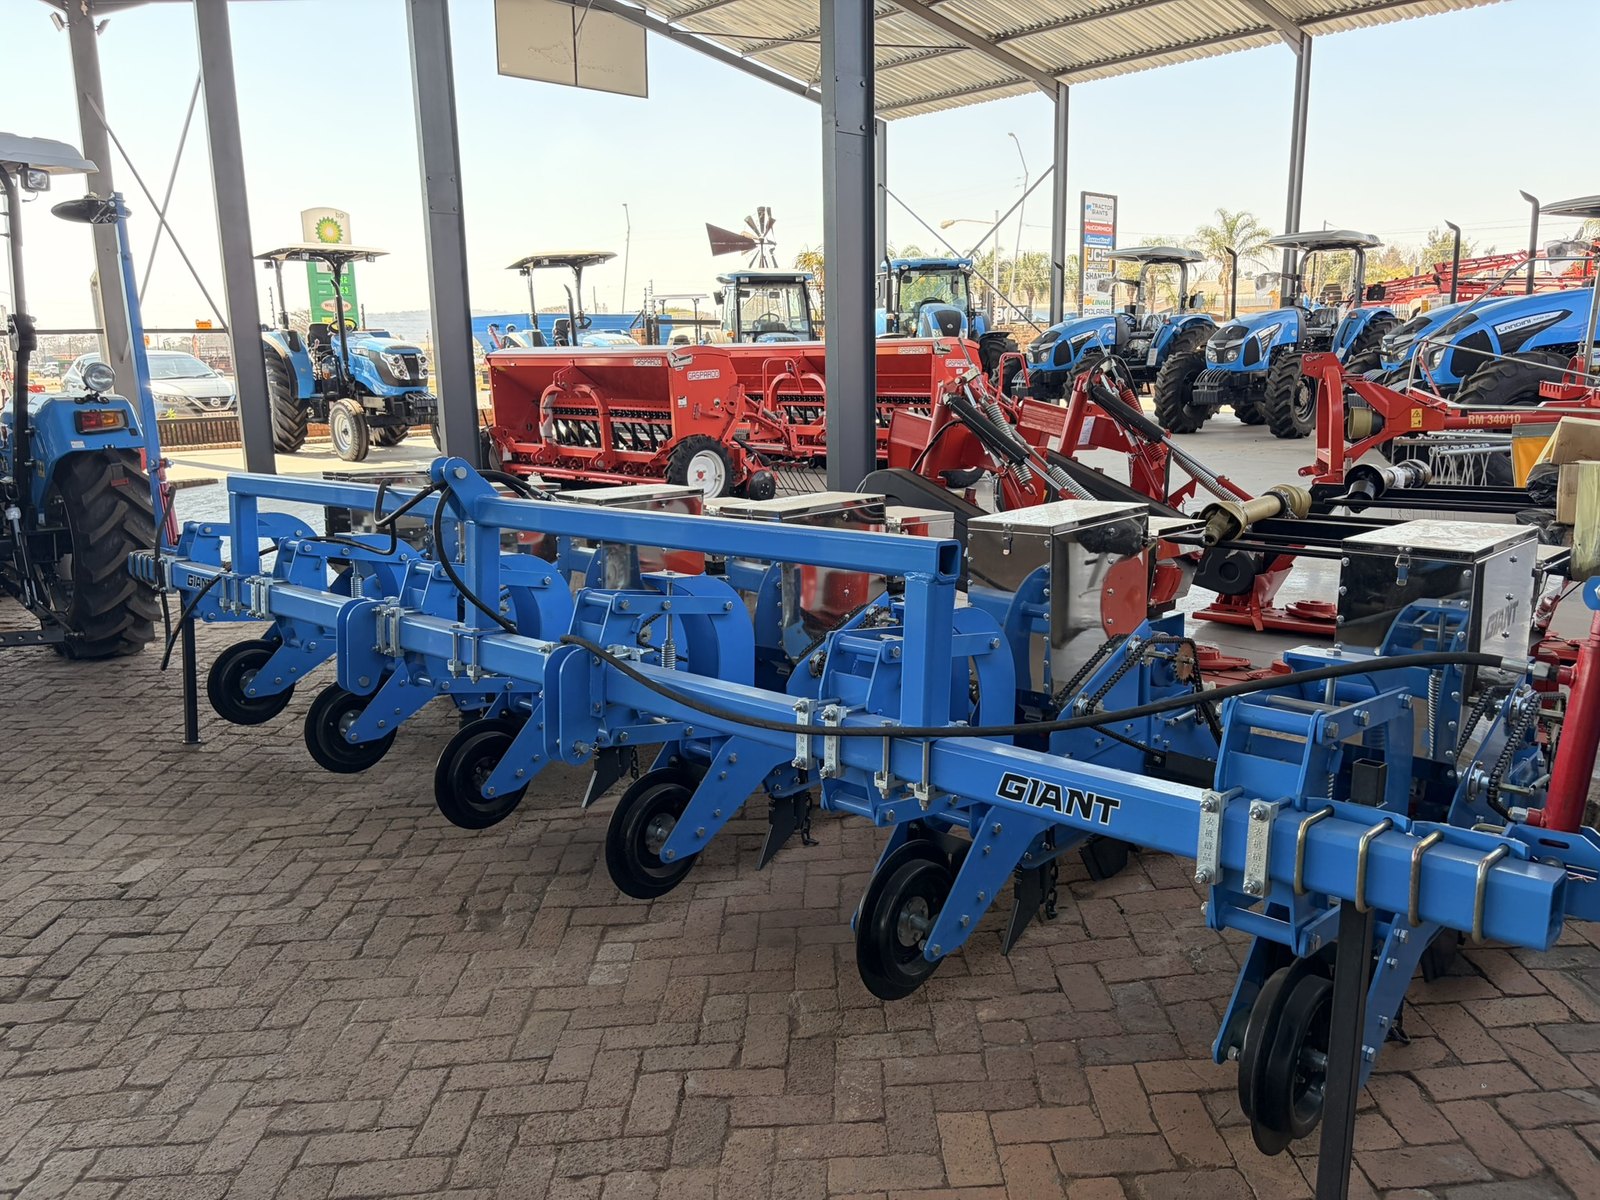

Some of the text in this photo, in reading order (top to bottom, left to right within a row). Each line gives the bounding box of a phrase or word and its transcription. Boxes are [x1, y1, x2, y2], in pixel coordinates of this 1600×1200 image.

[1092, 203, 1113, 211] TRACTOR
[1091, 209, 1109, 217] GIANTS
[1088, 247, 1109, 261] JCB
[1092, 298, 1111, 306] LINHAI
[1083, 307, 1111, 316] POLARIS
[1498, 318, 1532, 333] LANDINI
[688, 370, 720, 380] GASPARDO
[1468, 413, 1521, 425] RM 340/10
[187, 573, 212, 591] GIAN
[996, 772, 1120, 825] GIANT
